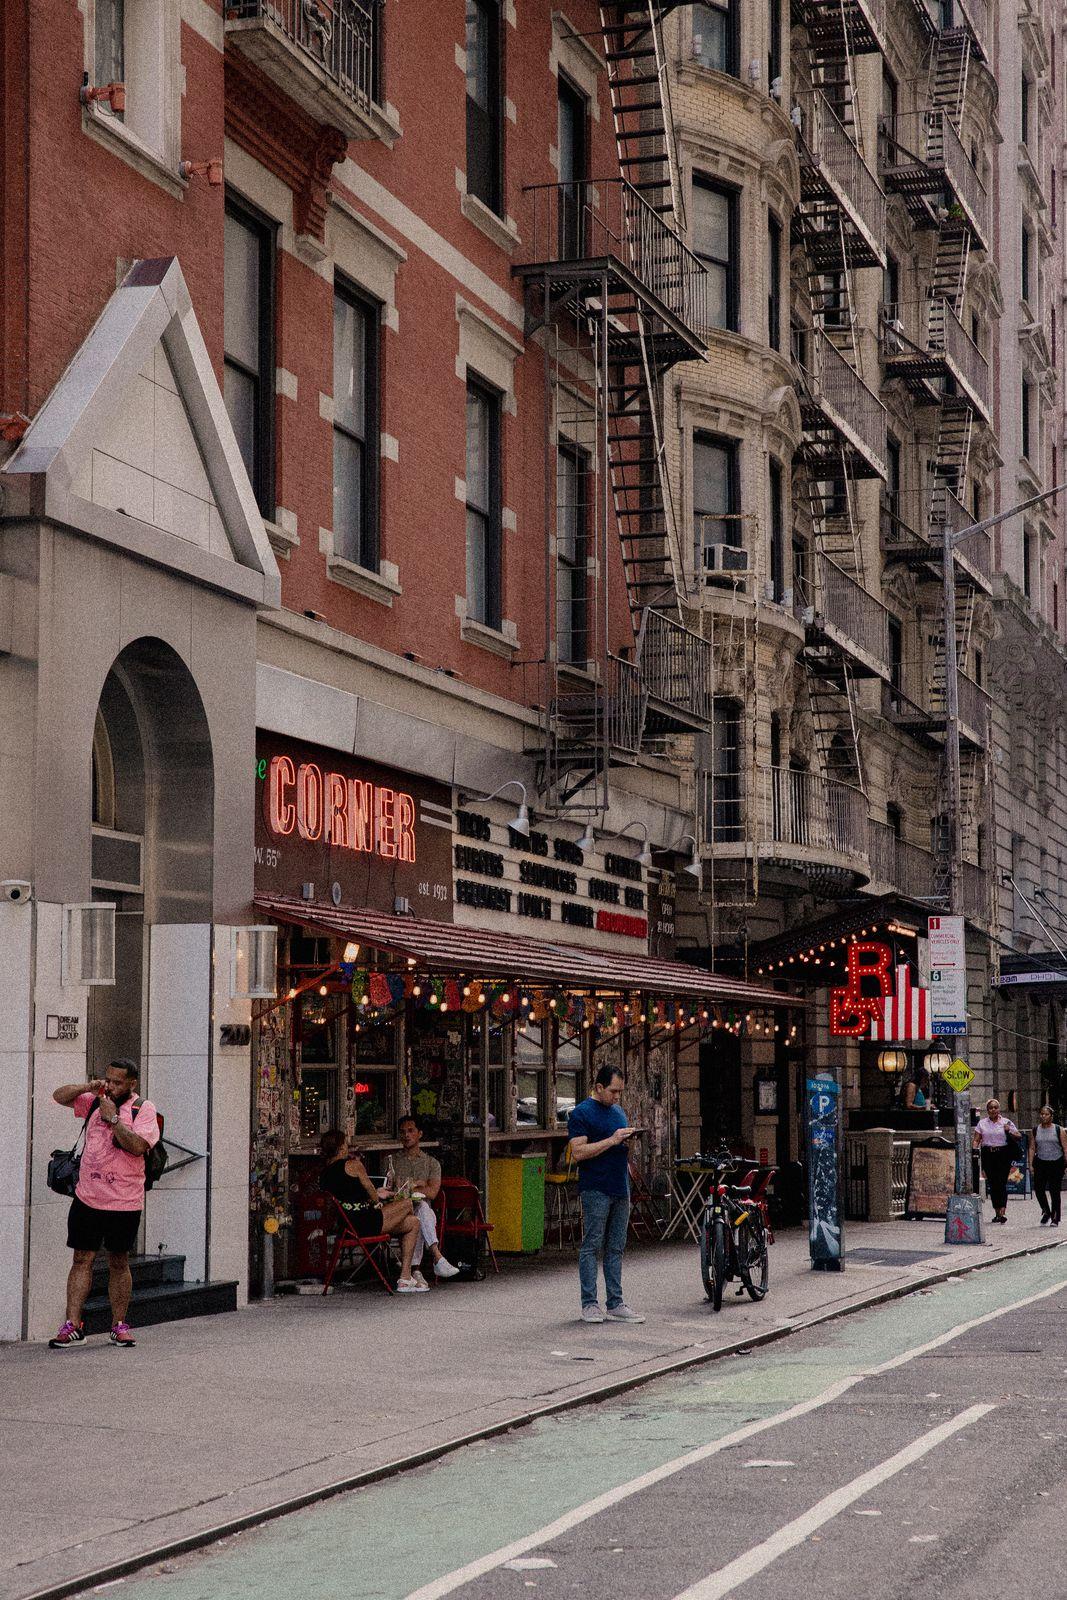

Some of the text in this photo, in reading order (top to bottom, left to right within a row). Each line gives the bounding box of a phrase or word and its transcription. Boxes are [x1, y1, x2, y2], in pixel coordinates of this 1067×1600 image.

[270, 755, 416, 863] CORNER
[455, 843, 504, 878] BURGERS
[519, 859, 578, 895] SANDWICHES
[456, 878, 512, 913] BREAKFAST
[518, 891, 551, 920] LUNCH
[561, 900, 594, 929] DINNER
[59, 1016, 79, 1024] DREAM
[59, 1024, 77, 1032] HOTEL
[932, 1026, 958, 1034] 102916
[59, 1031, 79, 1040] GROUP
[947, 1070, 970, 1080] SLOW
[819, 1095, 830, 1113] P
